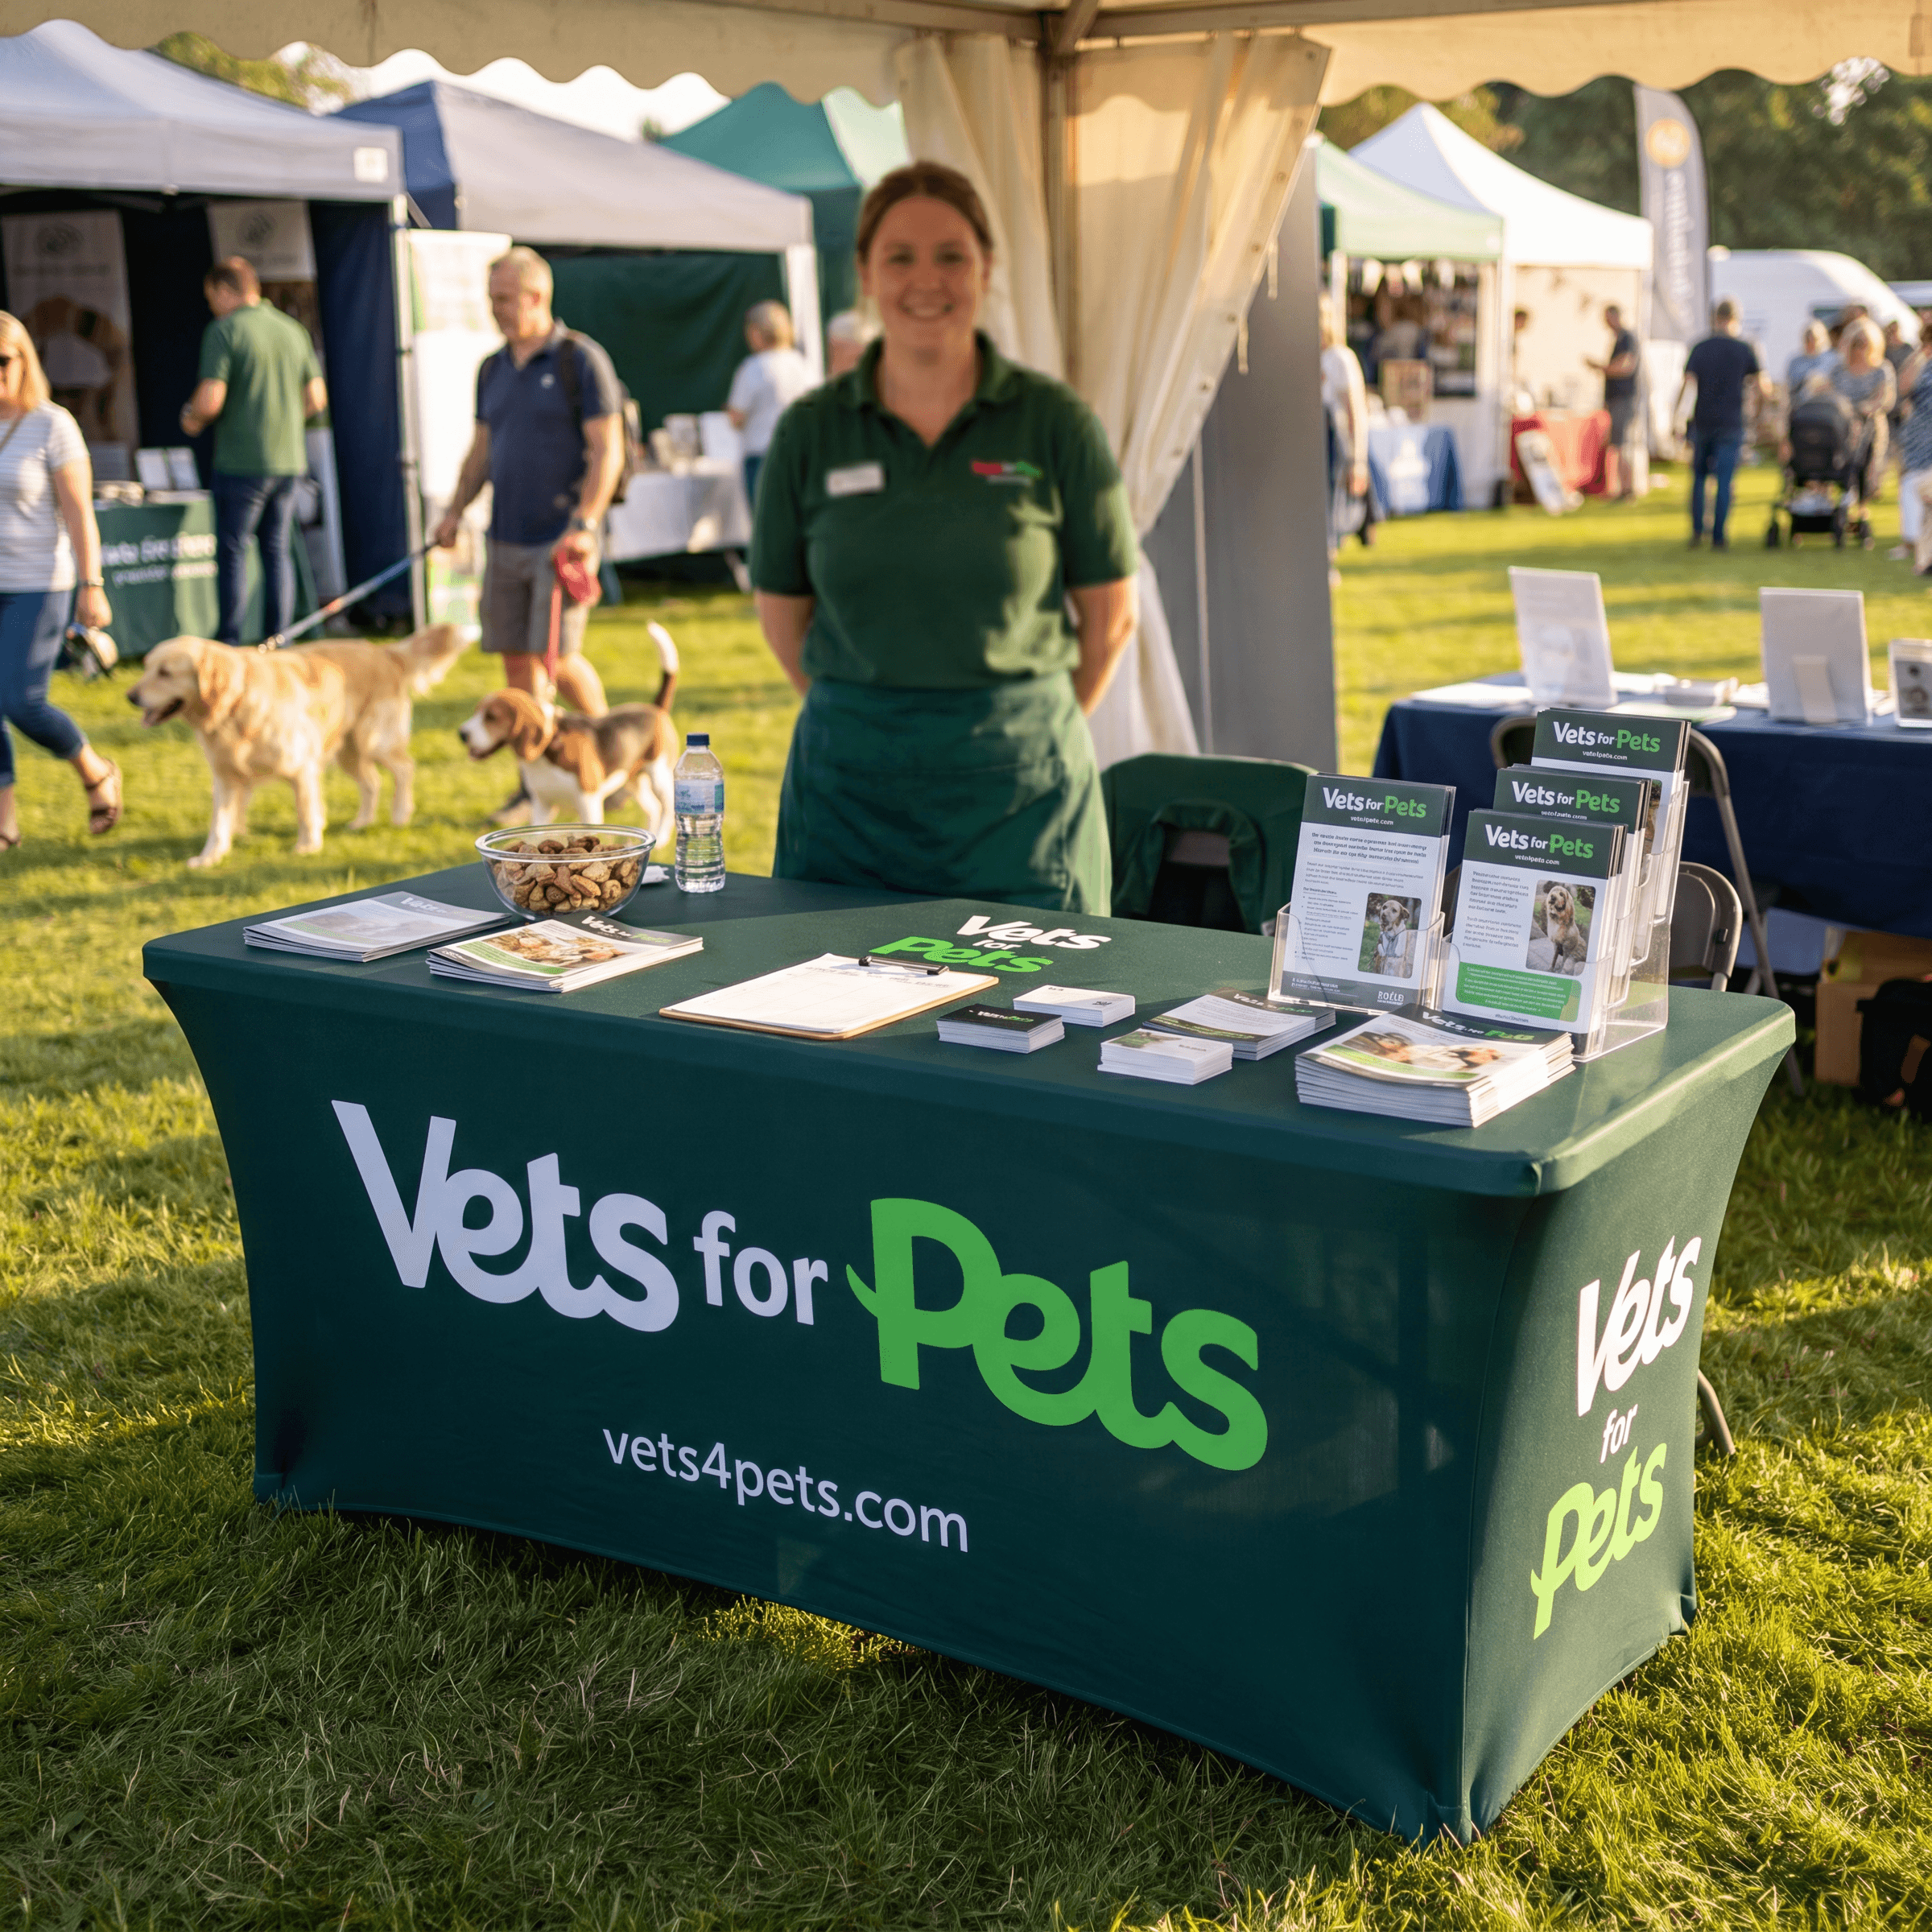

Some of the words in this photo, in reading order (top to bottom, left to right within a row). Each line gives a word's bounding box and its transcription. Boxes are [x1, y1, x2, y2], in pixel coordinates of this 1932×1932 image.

[1553, 720, 1596, 746] Vets
[1597, 732, 1615, 745] for
[1616, 729, 1661, 753] Pets
[1323, 786, 1364, 811] Vets
[1365, 798, 1381, 811] for
[1384, 795, 1427, 819] Pets
[1511, 780, 1555, 806] Vets
[1557, 791, 1575, 805] for
[1575, 788, 1620, 814] Pets
[1484, 824, 1530, 850] Vets
[1530, 836, 1549, 849] for
[1549, 833, 1594, 859] Pets
[956, 914, 1113, 950] Vets
[972, 939, 1022, 951] for
[869, 935, 1055, 972] Pets
[331, 1100, 679, 1332] Vets
[693, 1210, 828, 1325] for
[846, 1198, 1268, 1471] Pets
[1576, 1235, 1703, 1418] Vets
[1599, 1403, 1638, 1464] for
[603, 1428, 968, 1553] vets4pets.com
[1531, 1443, 1667, 1641] Pets
